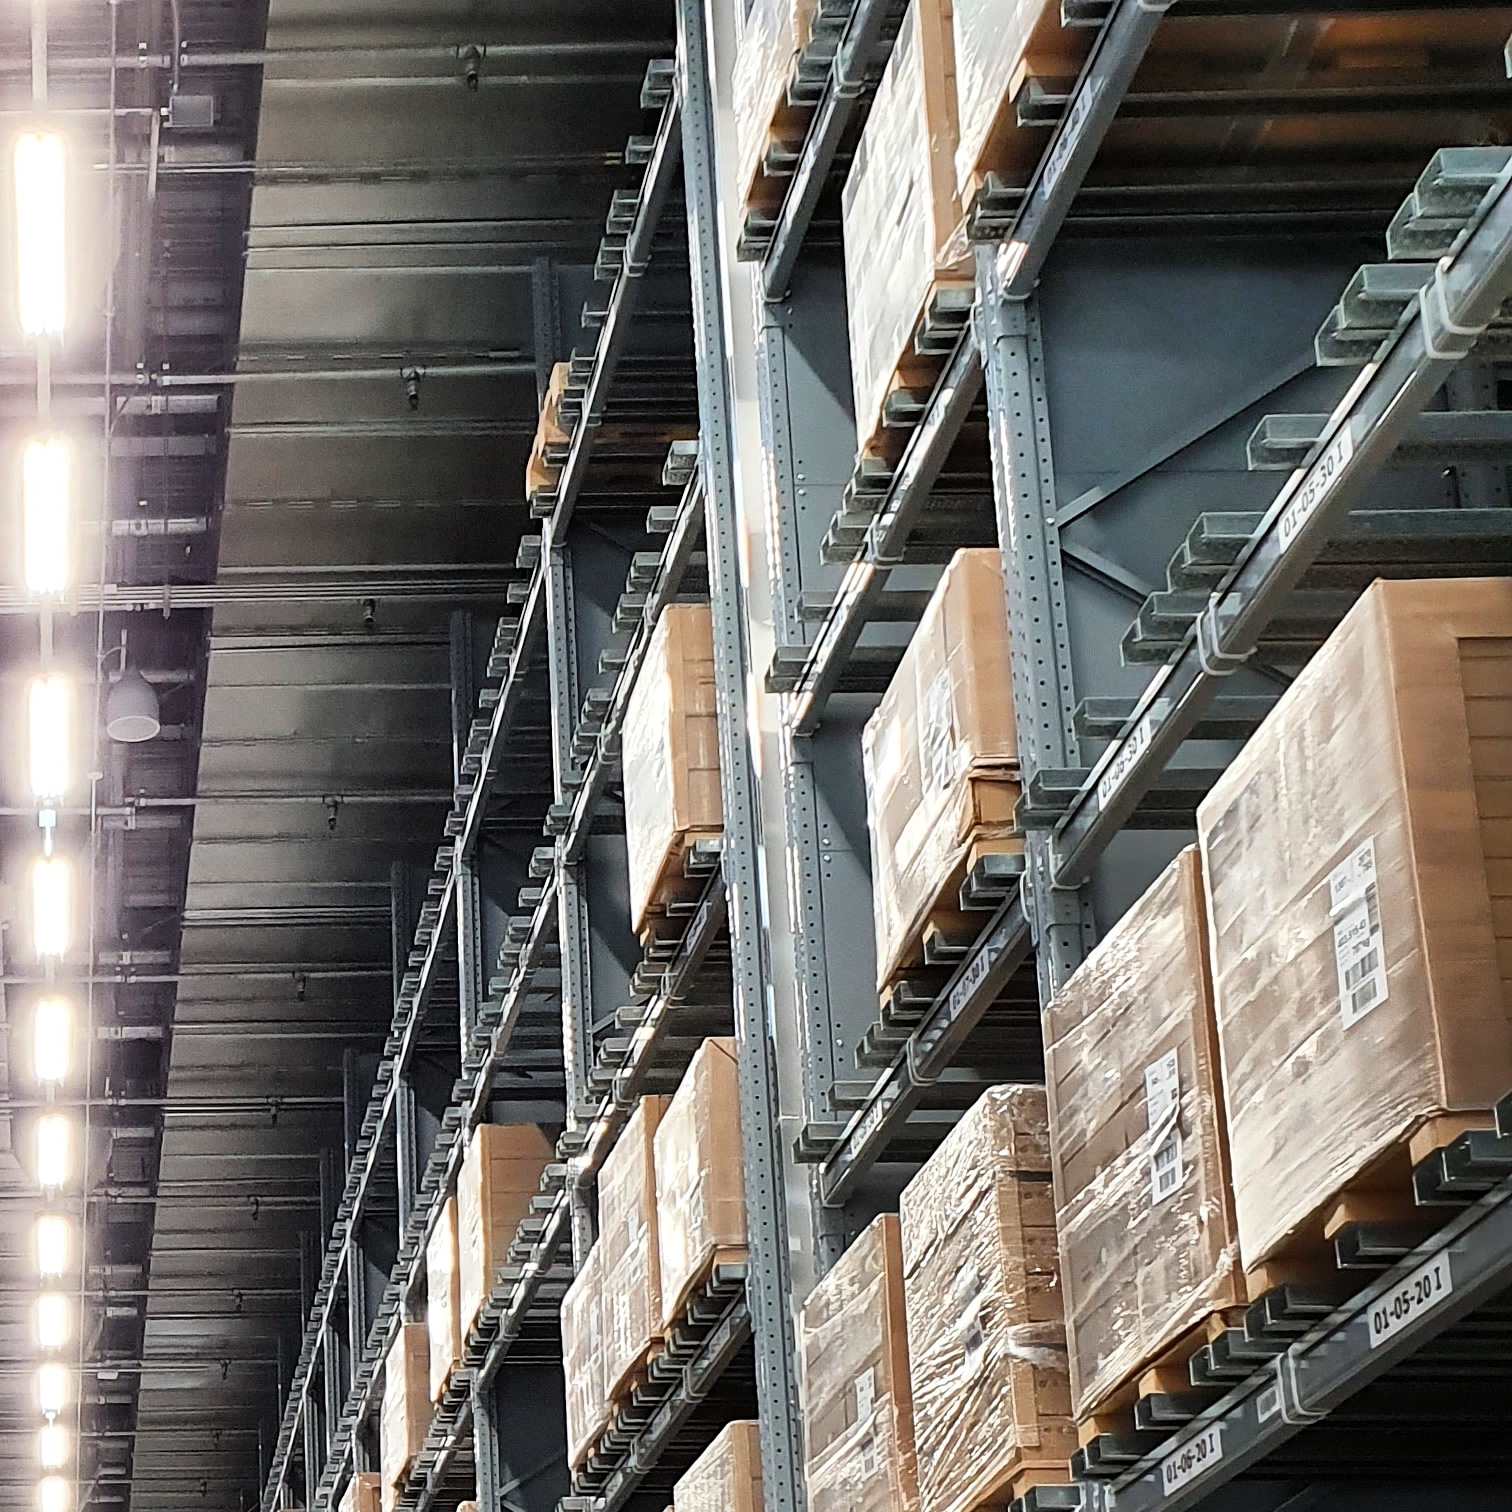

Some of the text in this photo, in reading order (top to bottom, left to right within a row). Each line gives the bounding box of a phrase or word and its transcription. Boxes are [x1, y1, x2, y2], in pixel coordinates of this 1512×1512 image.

[1284, 455, 1334, 538] 01-05-30
[1374, 1275, 1431, 1335] 01-05-20
[1166, 1438, 1207, 1484] 01-06-20
